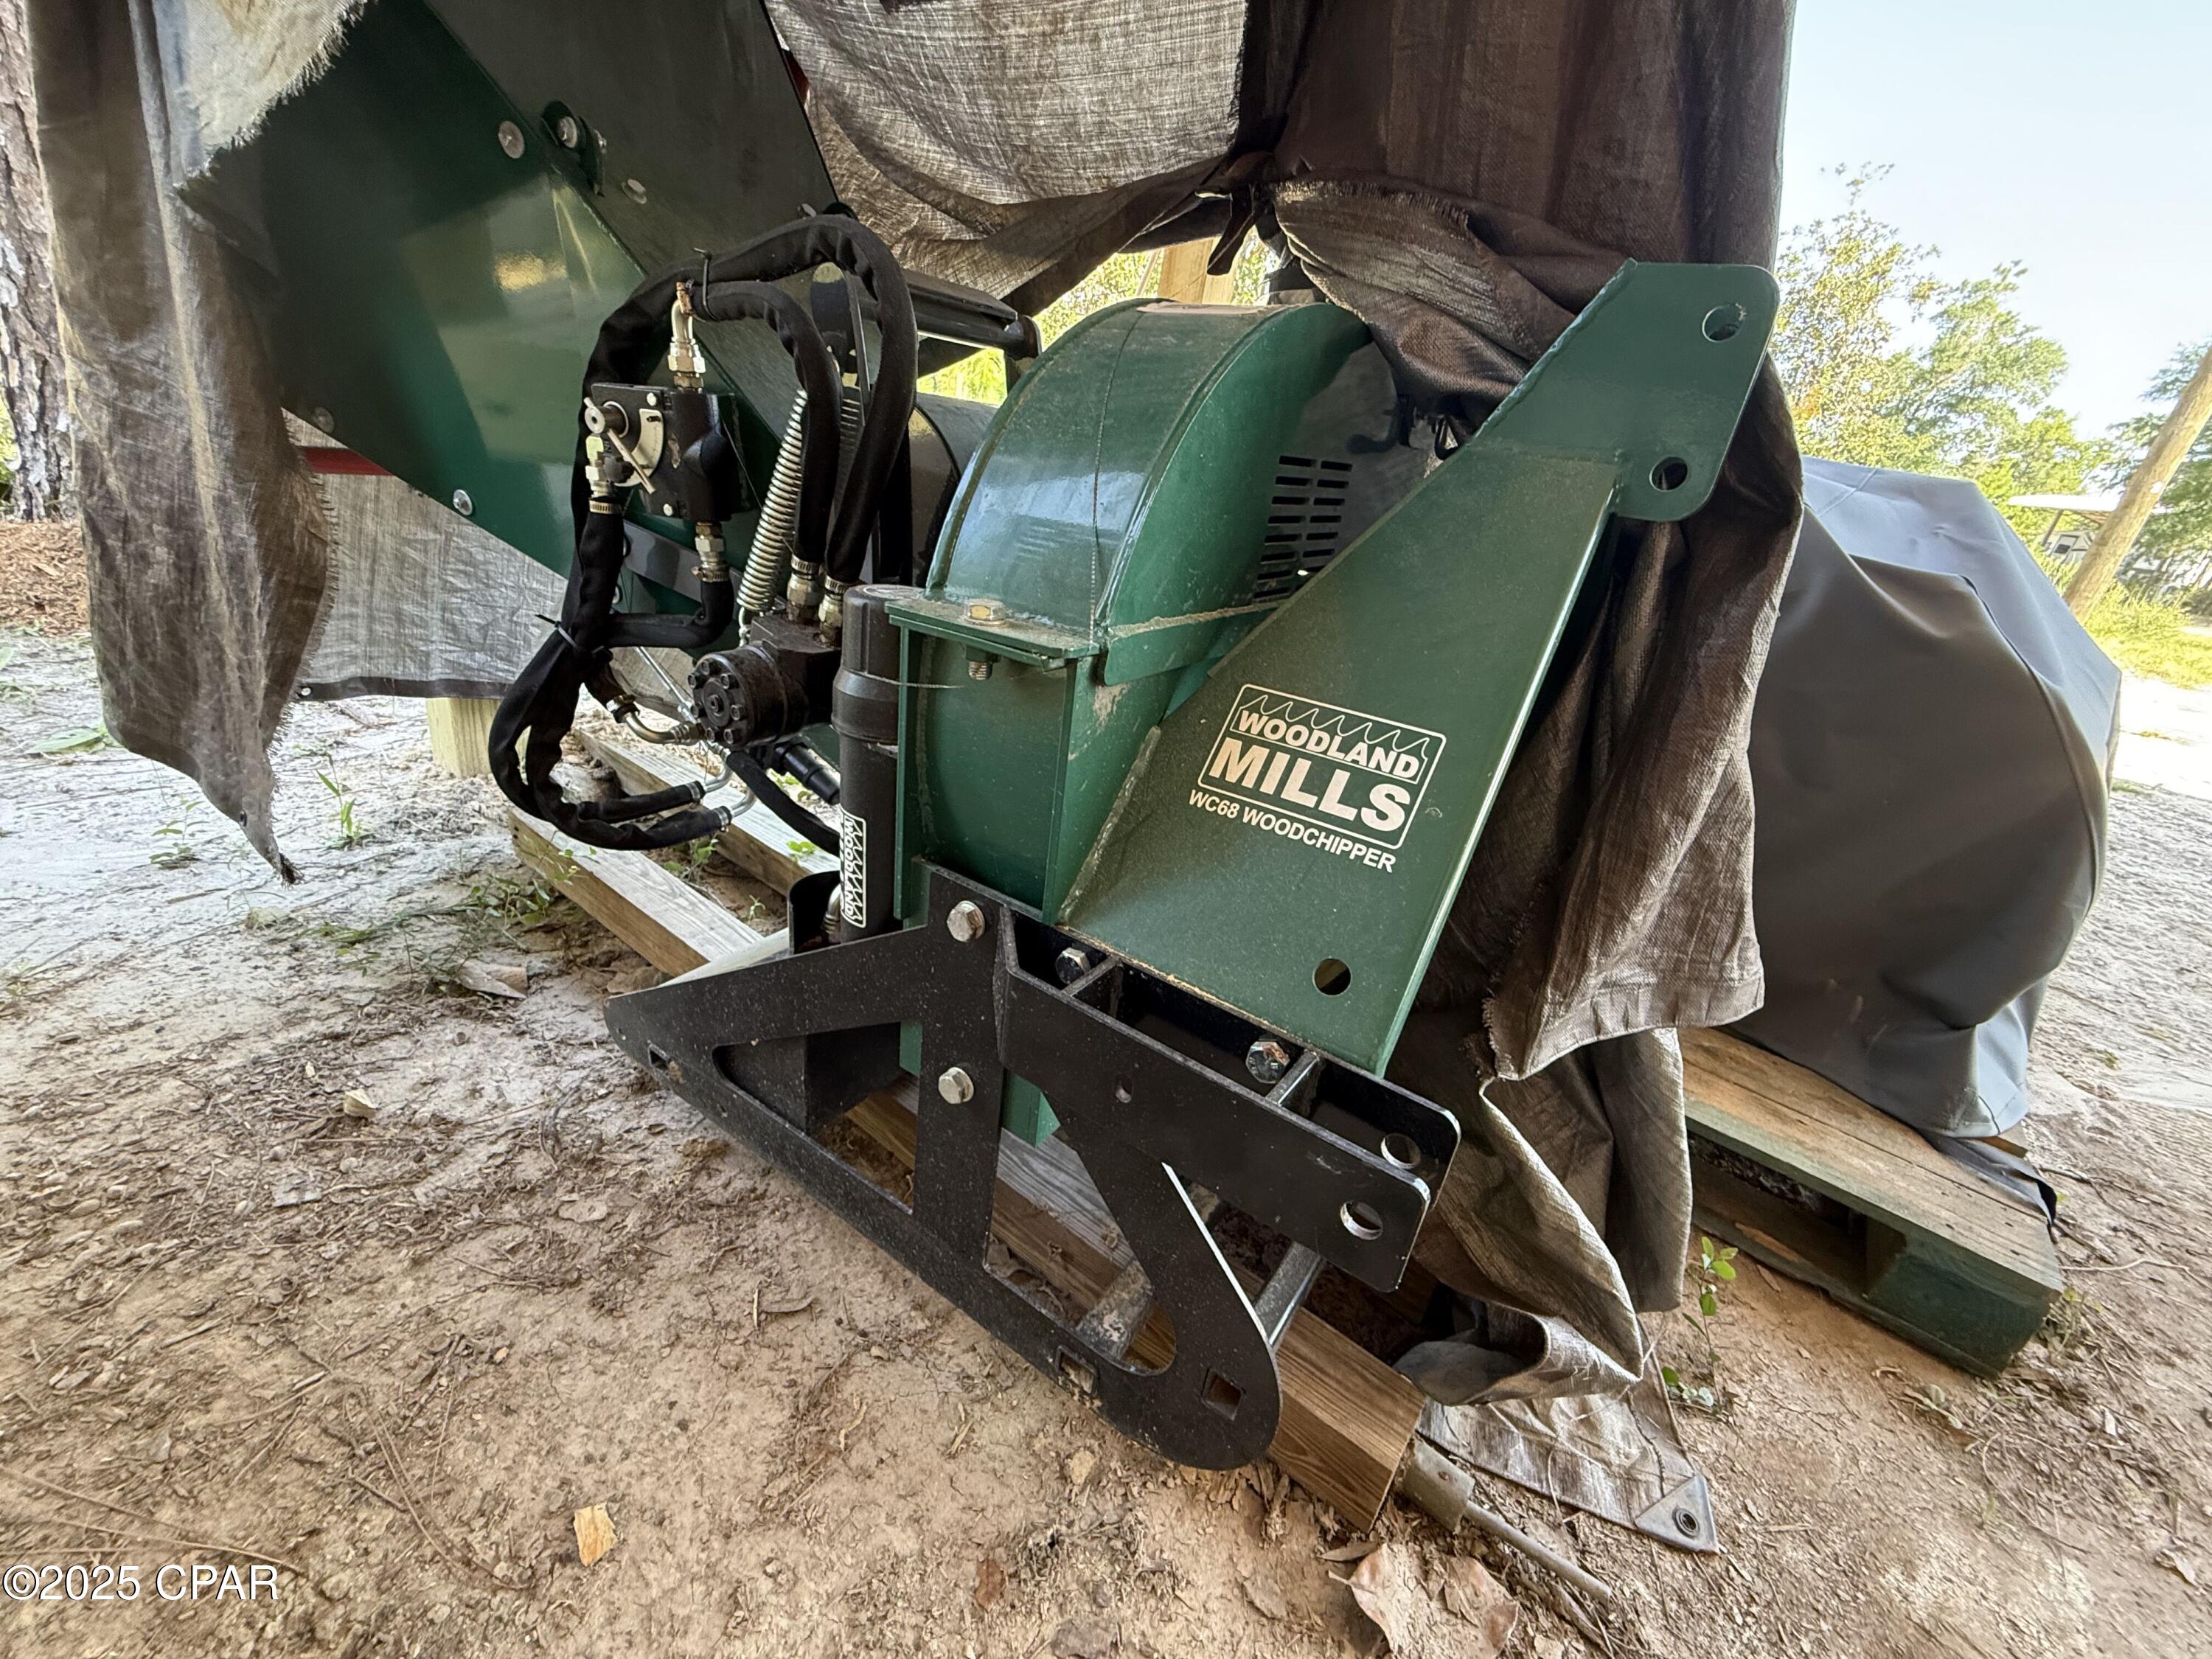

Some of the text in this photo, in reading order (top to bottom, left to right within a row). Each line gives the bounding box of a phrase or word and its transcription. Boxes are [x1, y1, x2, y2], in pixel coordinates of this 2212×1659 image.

[1208, 737, 1411, 832] MILLS
[1238, 710, 1420, 779] WOODLAND
[844, 819, 854, 916] WOODLAND
[1189, 790, 1397, 873] WC68 WOODCHIPPER
